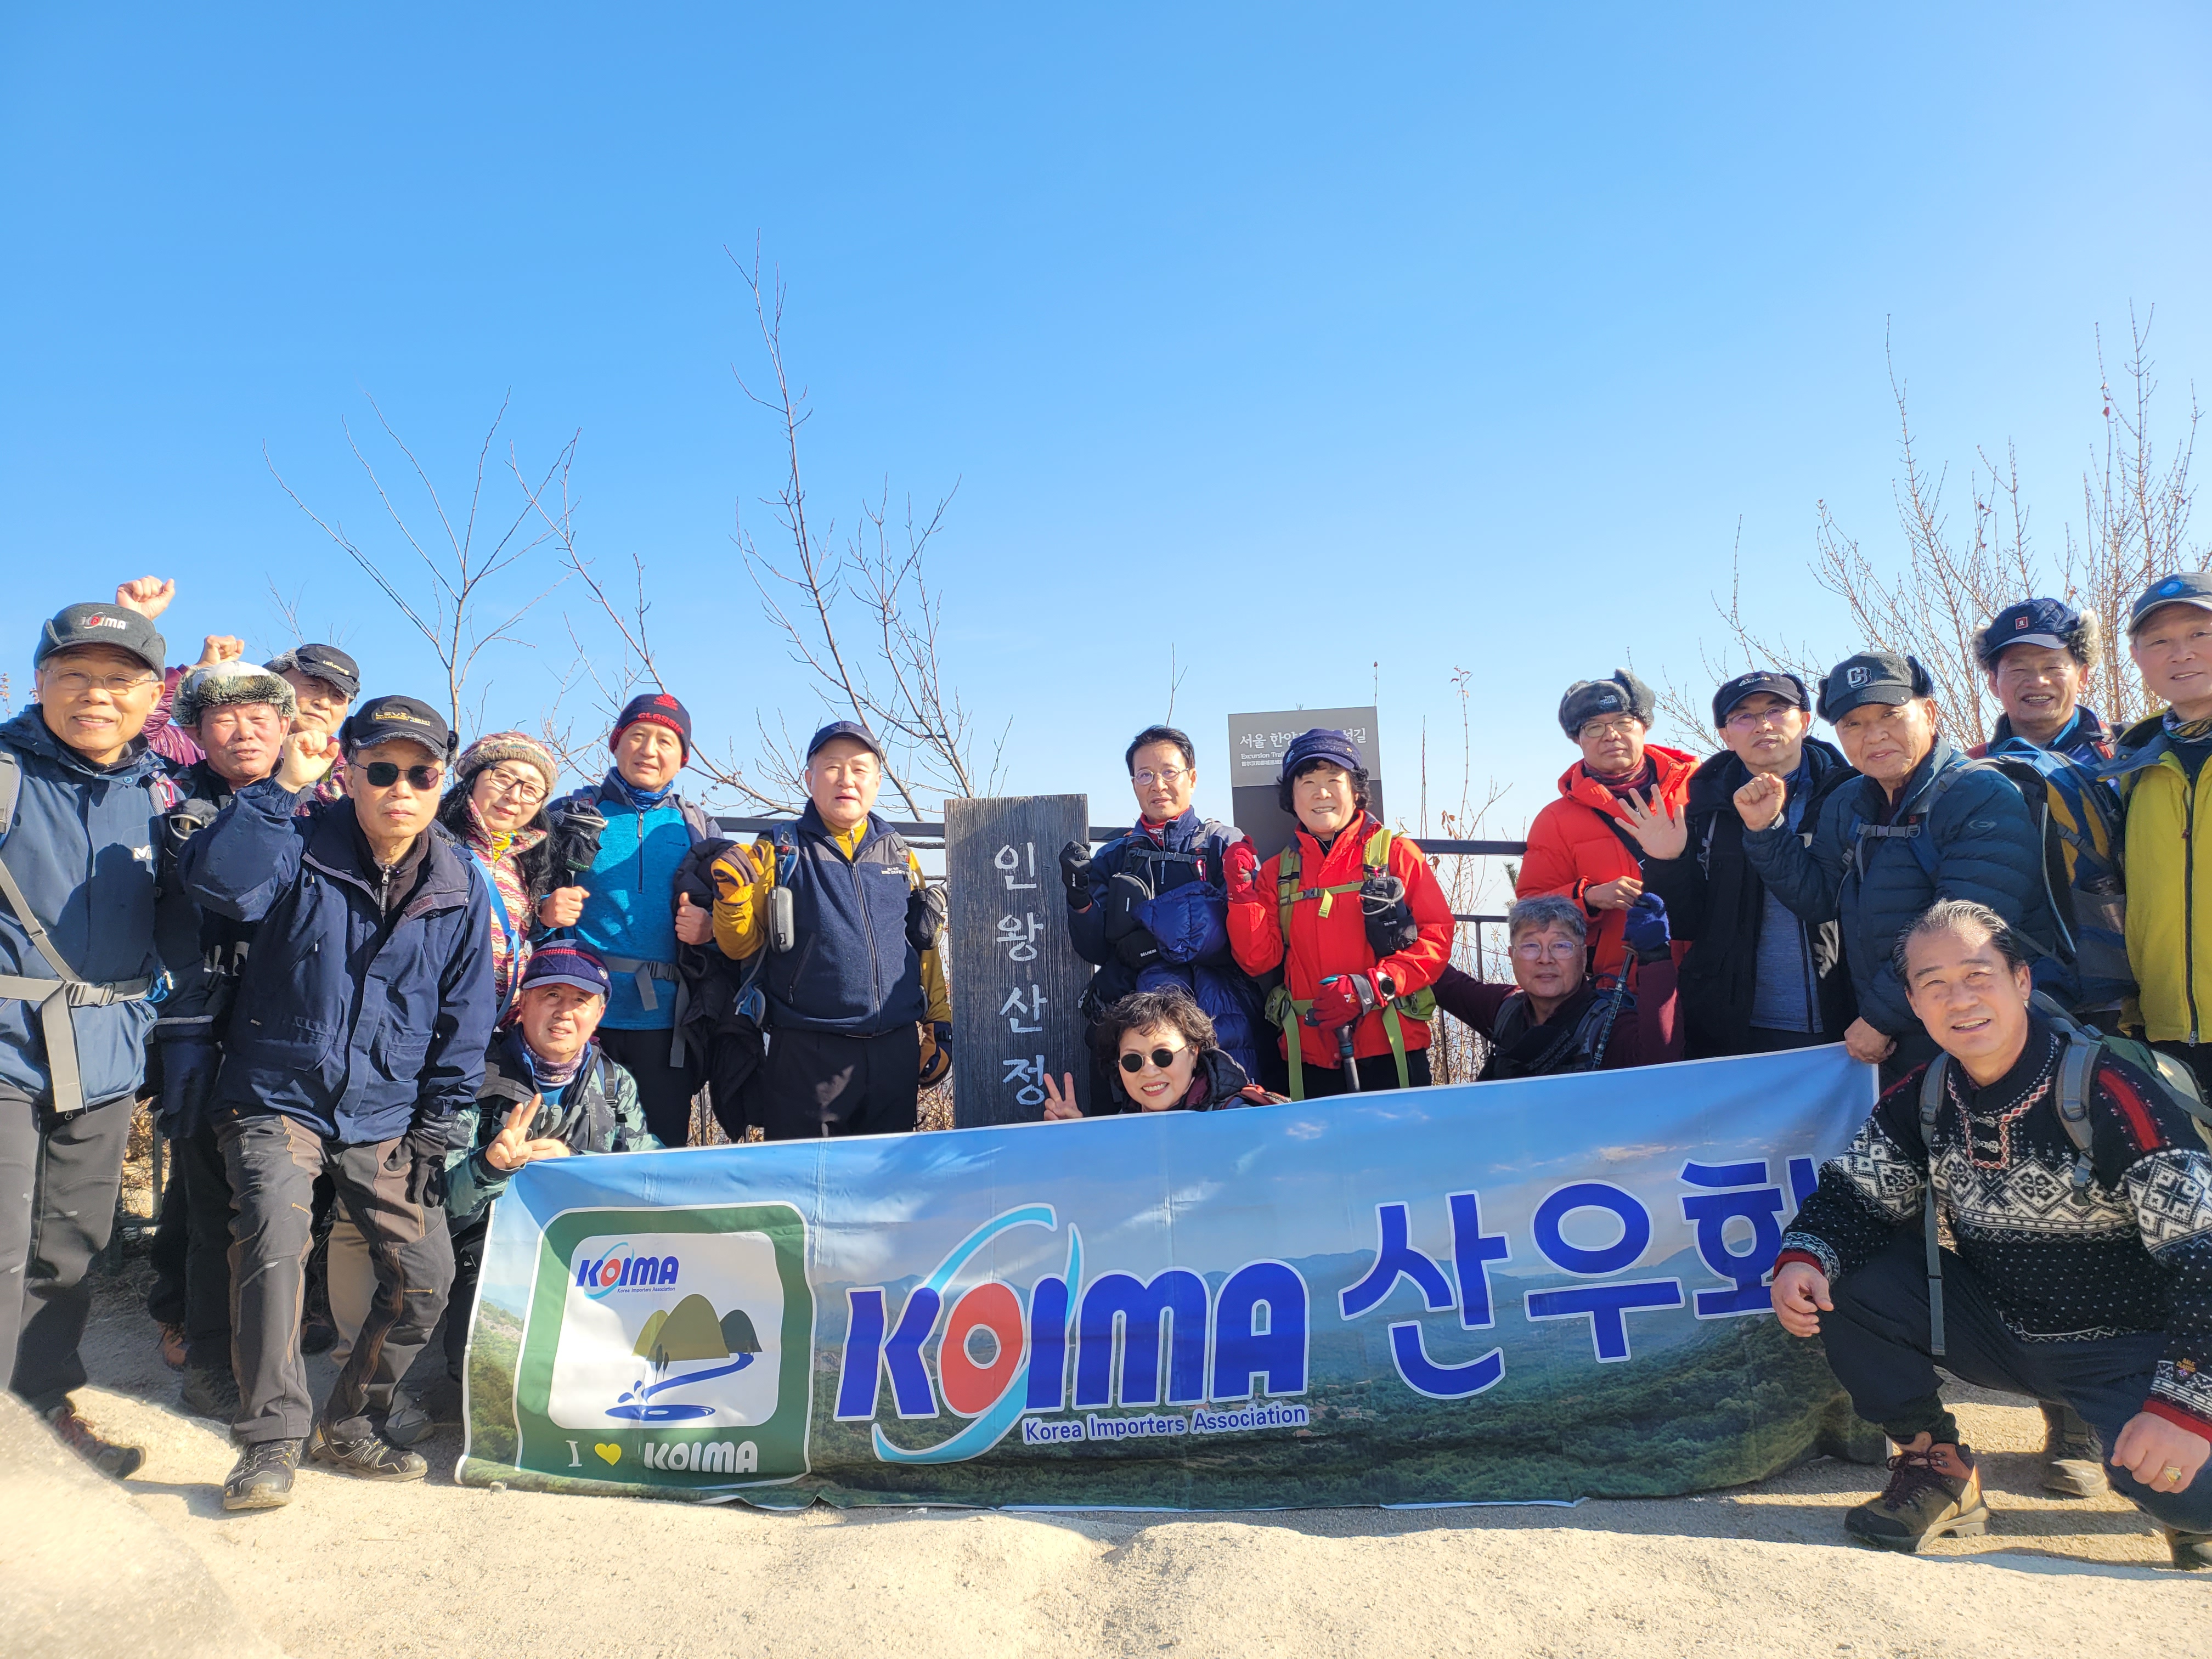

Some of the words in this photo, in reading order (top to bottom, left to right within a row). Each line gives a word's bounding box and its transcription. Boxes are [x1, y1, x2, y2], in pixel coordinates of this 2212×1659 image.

[1239, 733, 1267, 749] 서울
[575, 1256, 679, 1287] KOIMA
[833, 1258, 1311, 1421] KOIMA
[1025, 1422, 1082, 1441] Korea
[1090, 1414, 1185, 1438] Importers
[1194, 1406, 1306, 1431] Association
[565, 1440, 583, 1468] I
[644, 1441, 758, 1474] KOIMA
